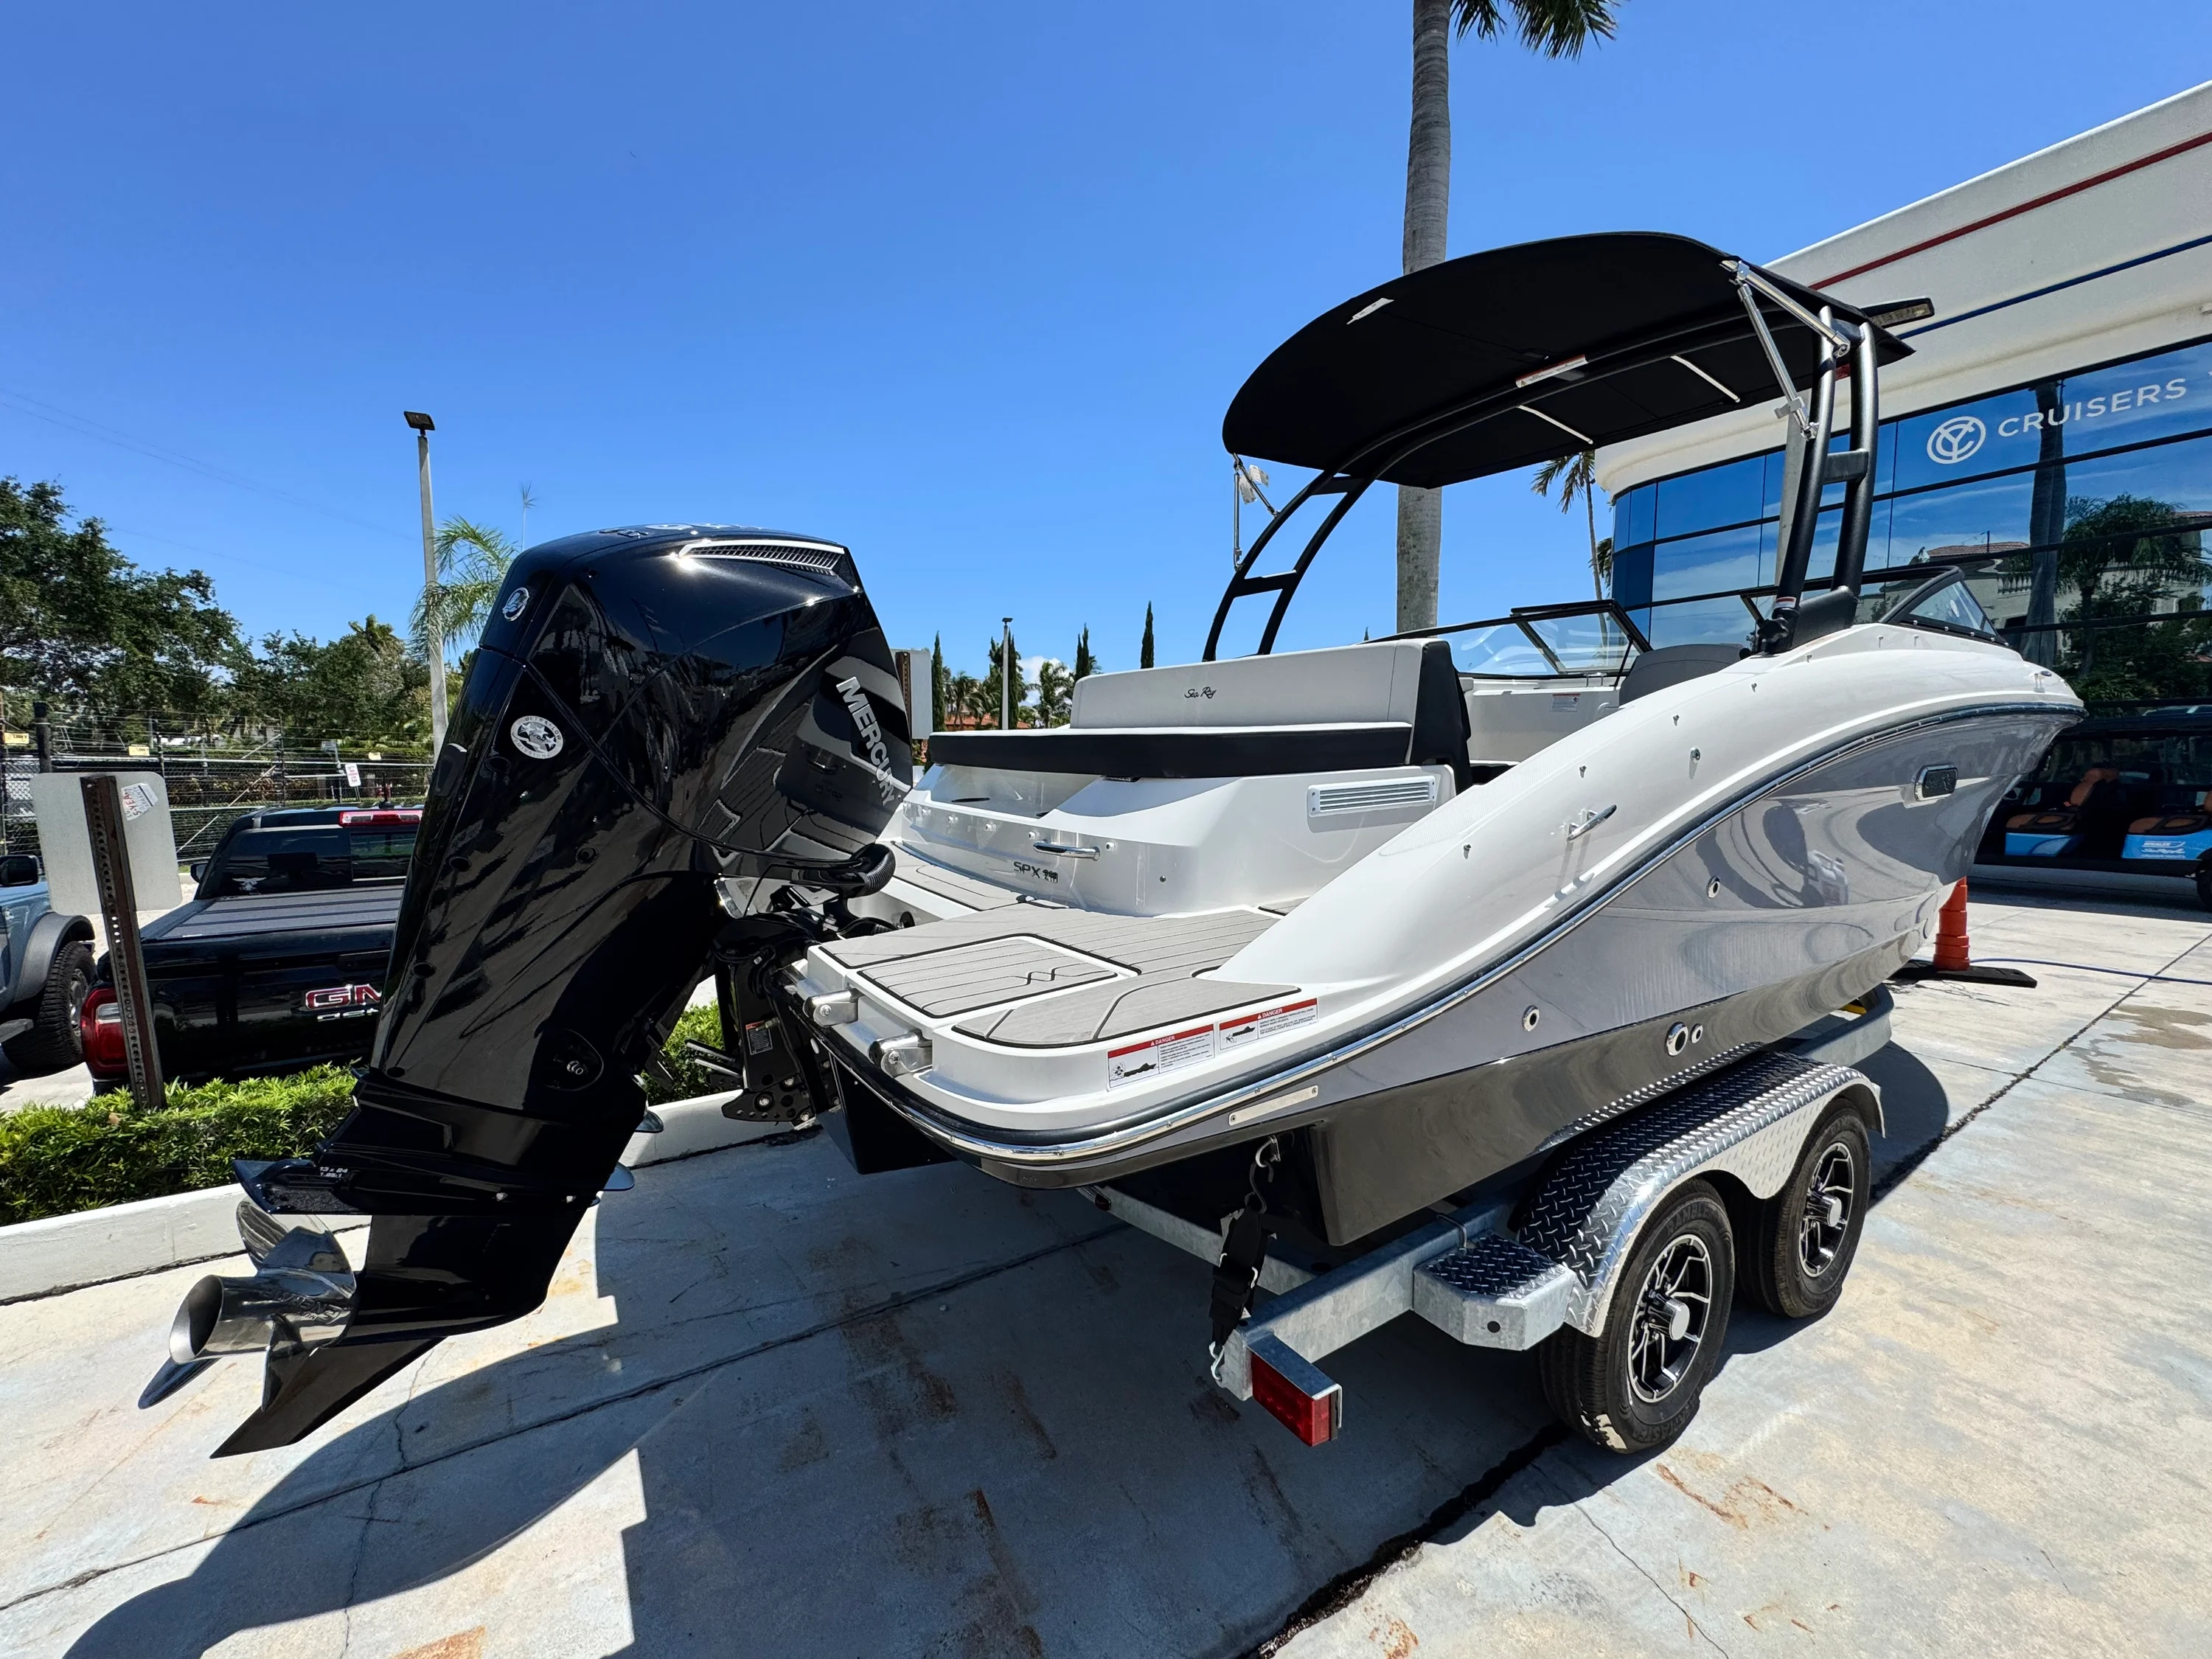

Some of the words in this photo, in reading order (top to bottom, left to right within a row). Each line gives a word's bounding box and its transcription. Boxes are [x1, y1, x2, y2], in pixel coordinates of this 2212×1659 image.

[1997, 378, 2187, 437] CRUISERS
[1184, 688, 1200, 698] Sea
[835, 676, 895, 806] MERCURY
[1013, 861, 1041, 879] SPX
[305, 984, 383, 1010] GM
[1262, 1008, 1283, 1018] DANGER
[1155, 1035, 1175, 1045] DANGER
